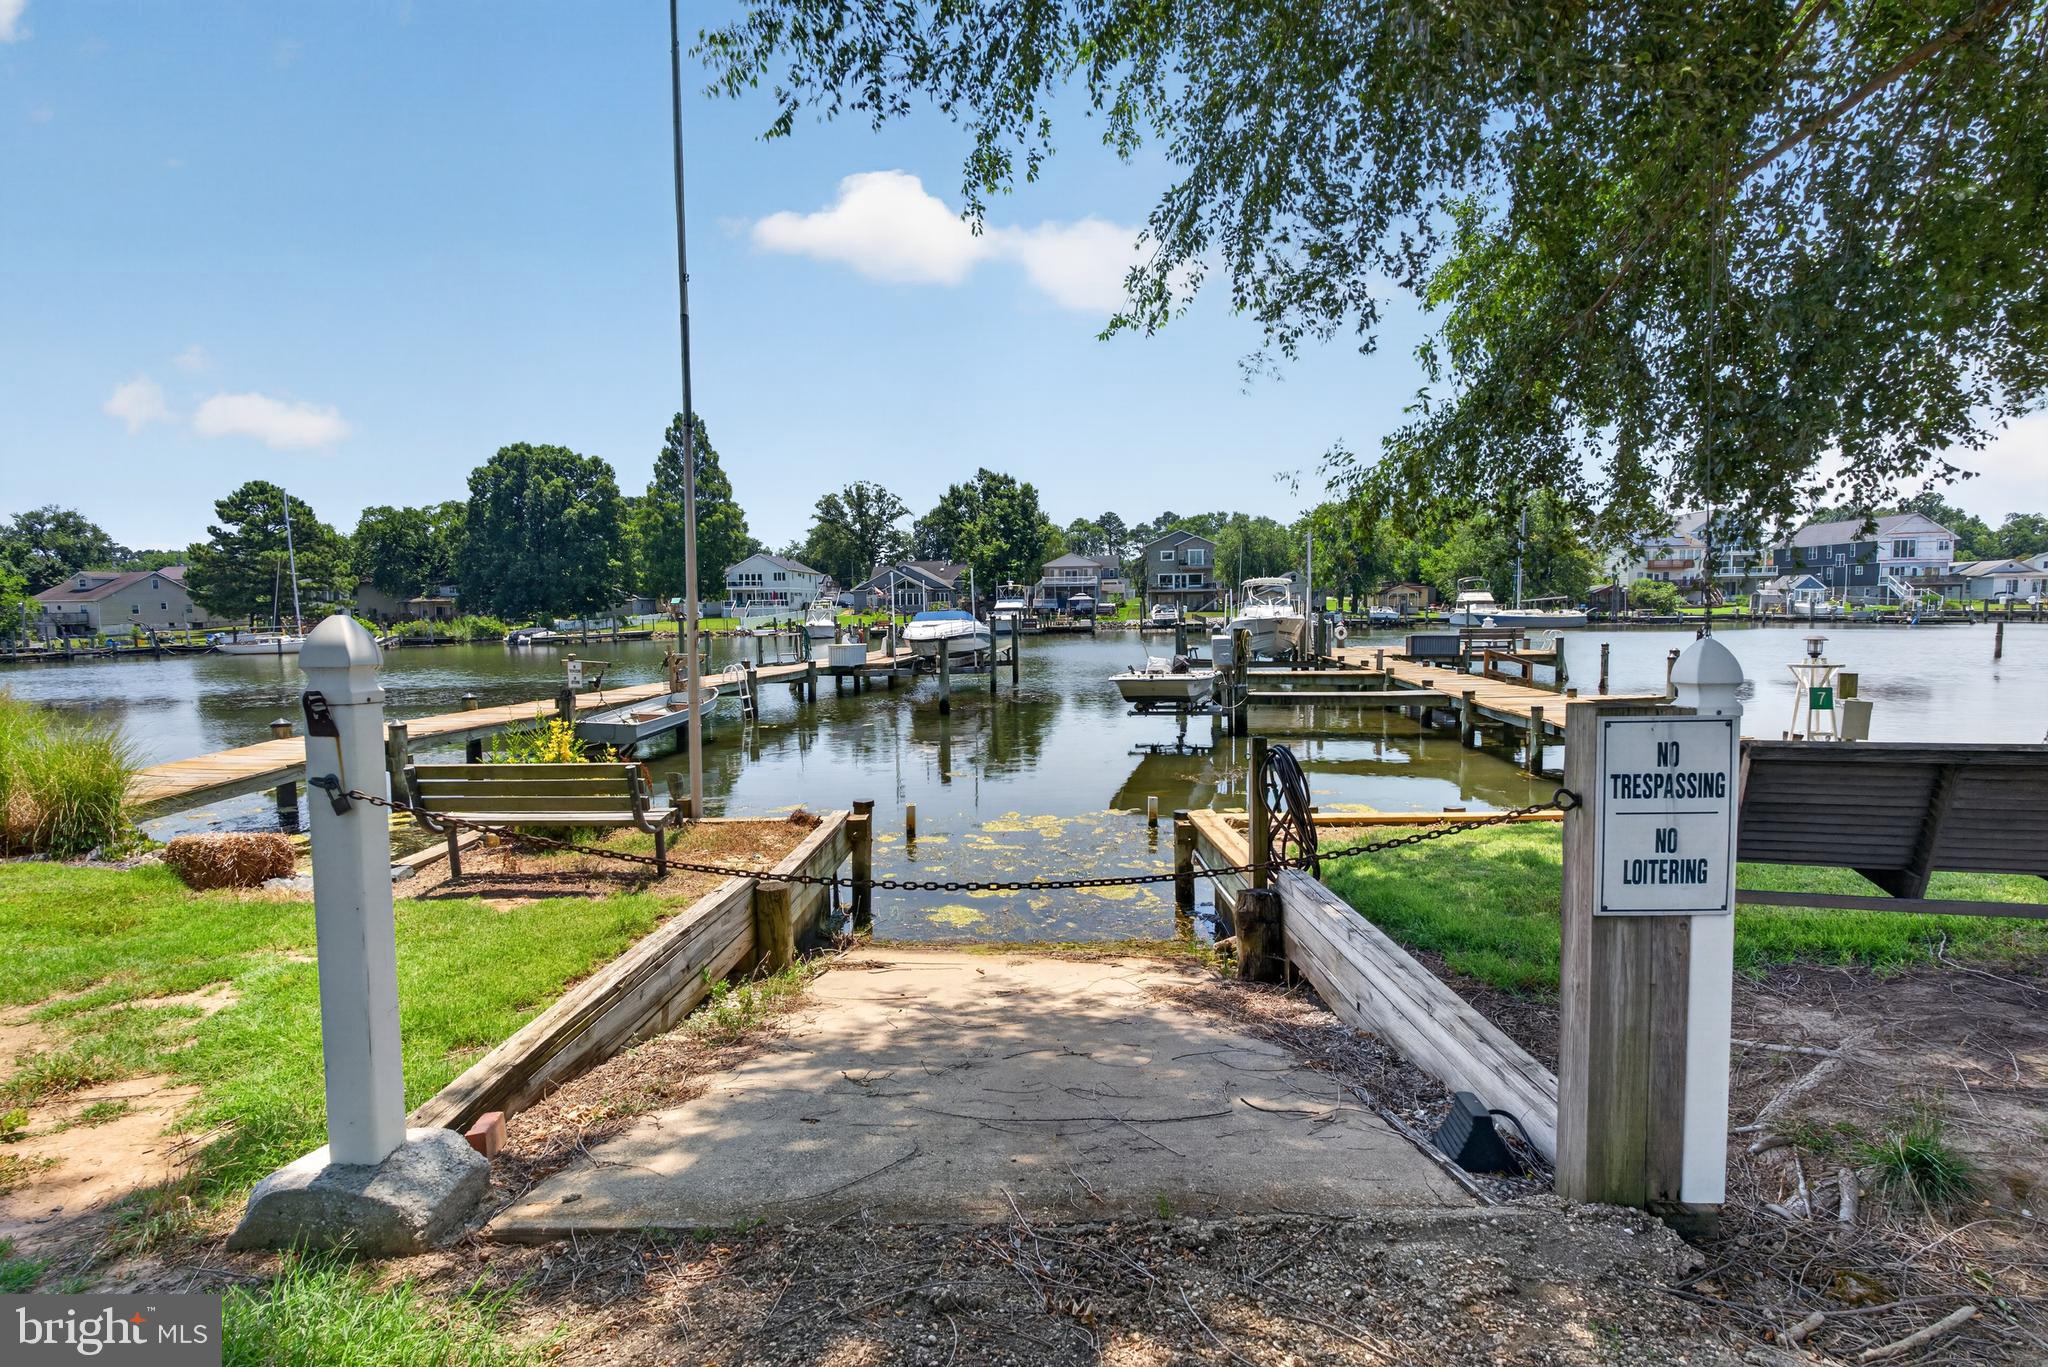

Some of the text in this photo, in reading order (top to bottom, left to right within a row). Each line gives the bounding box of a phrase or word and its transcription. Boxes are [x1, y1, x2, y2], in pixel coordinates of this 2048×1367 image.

[1816, 691, 1827, 706] 7
[1656, 741, 1680, 768] NO
[1610, 772, 1726, 799] TRESPASSING
[1655, 828, 1678, 854] NO
[1623, 858, 1708, 885] LOITERING
